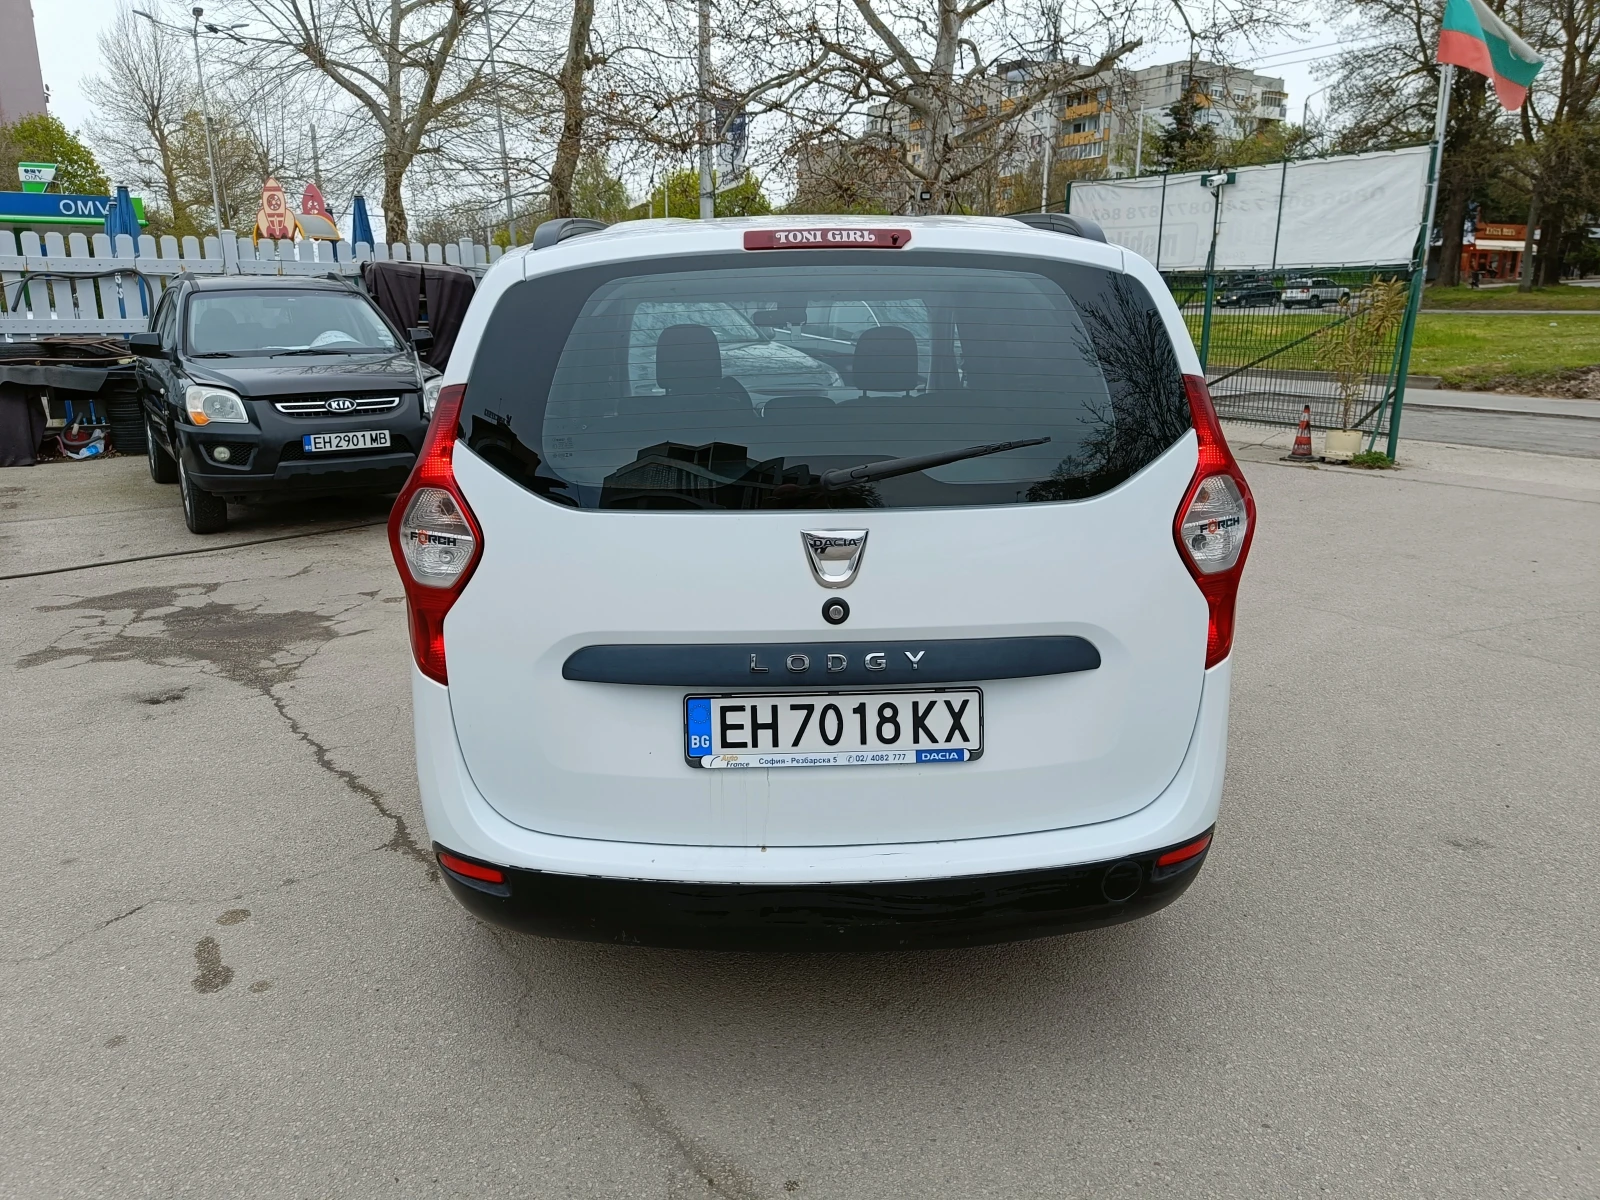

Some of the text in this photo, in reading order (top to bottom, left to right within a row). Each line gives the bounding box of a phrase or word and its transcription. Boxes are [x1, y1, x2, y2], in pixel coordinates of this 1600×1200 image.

[60, 199, 110, 215] OMV
[775, 230, 876, 243] TONI GIRL
[331, 401, 351, 409] KIA
[813, 539, 858, 547] DACIA
[750, 651, 926, 673] LODGY
[691, 736, 710, 748] BG
[870, 753, 889, 762] 4082
[892, 753, 907, 761] 777
[921, 752, 958, 760] DACIA
